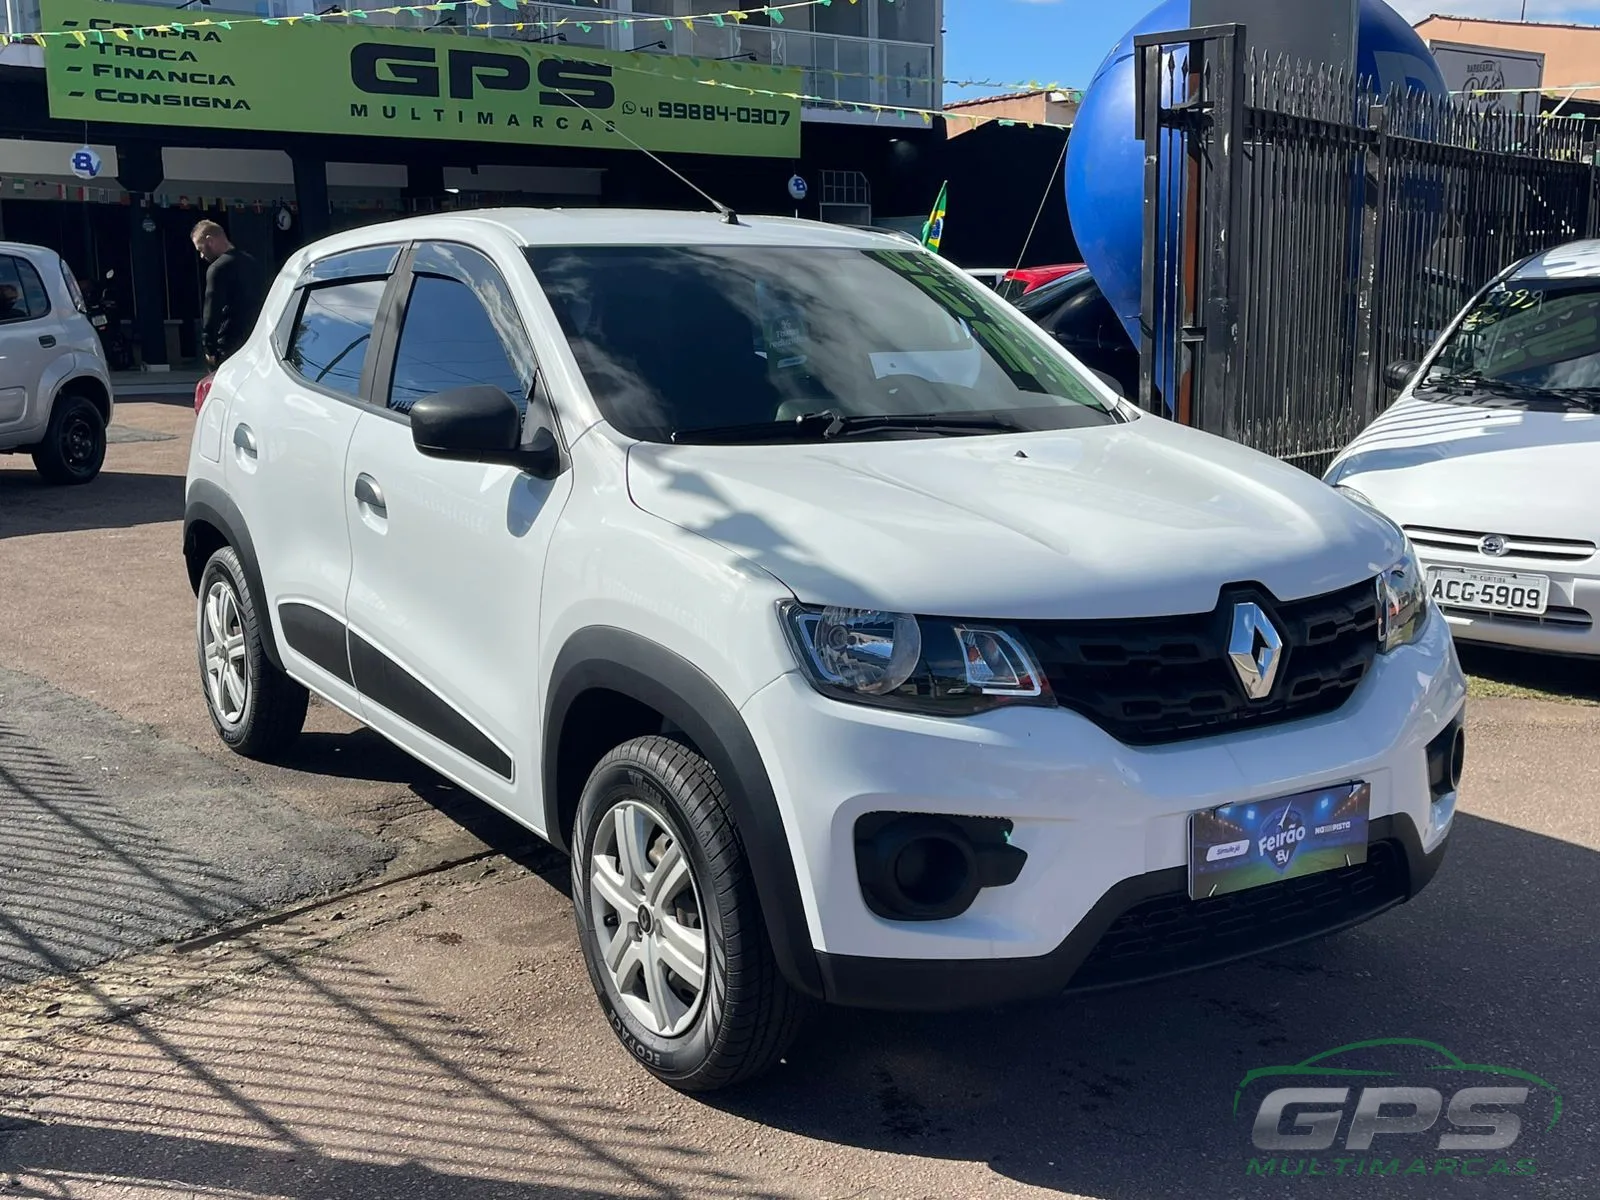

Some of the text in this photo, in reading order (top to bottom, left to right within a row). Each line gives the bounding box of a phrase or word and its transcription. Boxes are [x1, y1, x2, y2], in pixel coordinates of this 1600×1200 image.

[90, 41, 198, 62] TROCA
[93, 63, 236, 86] FINANCIA
[350, 42, 615, 109] GPS
[94, 88, 251, 111] CONSIGNA
[351, 103, 616, 133] MULTIMARCAS
[640, 101, 791, 126] 41 99884-0307
